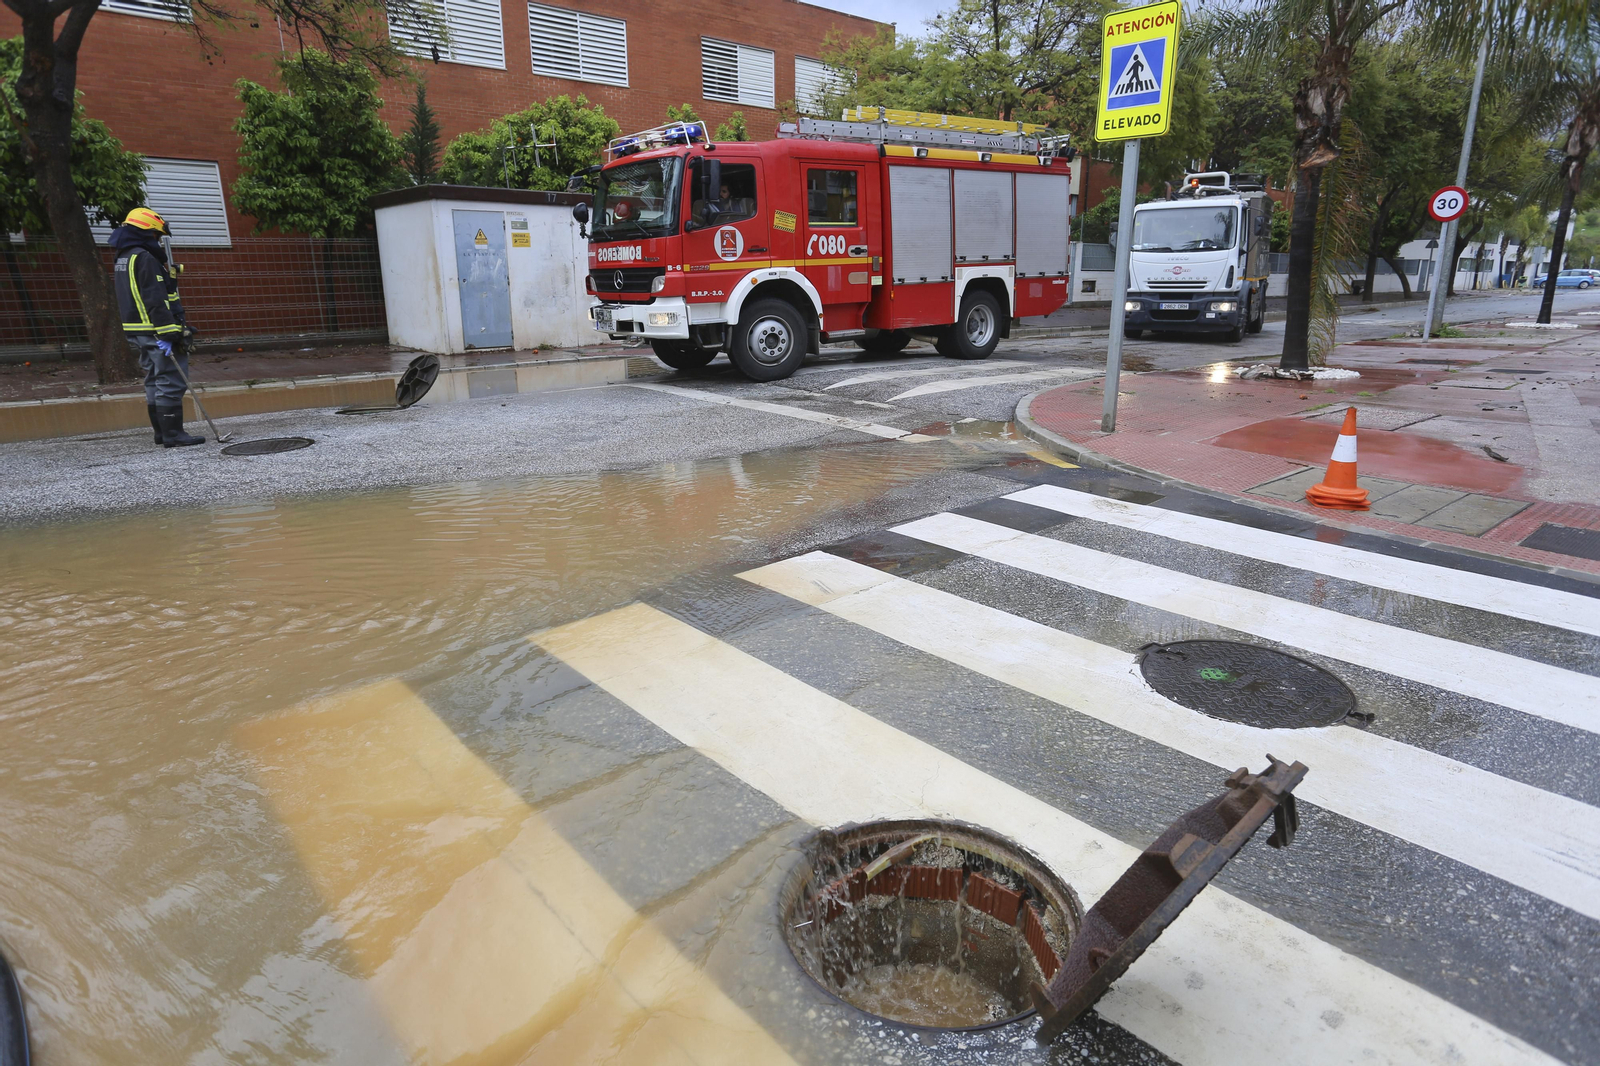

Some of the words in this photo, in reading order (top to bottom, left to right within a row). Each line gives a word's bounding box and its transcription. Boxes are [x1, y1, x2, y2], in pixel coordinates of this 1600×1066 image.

[1106, 11, 1175, 37] ATENCIÓN
[1103, 113, 1161, 130] ELEVADO
[1436, 198, 1459, 210] 30
[818, 235, 846, 255] 080
